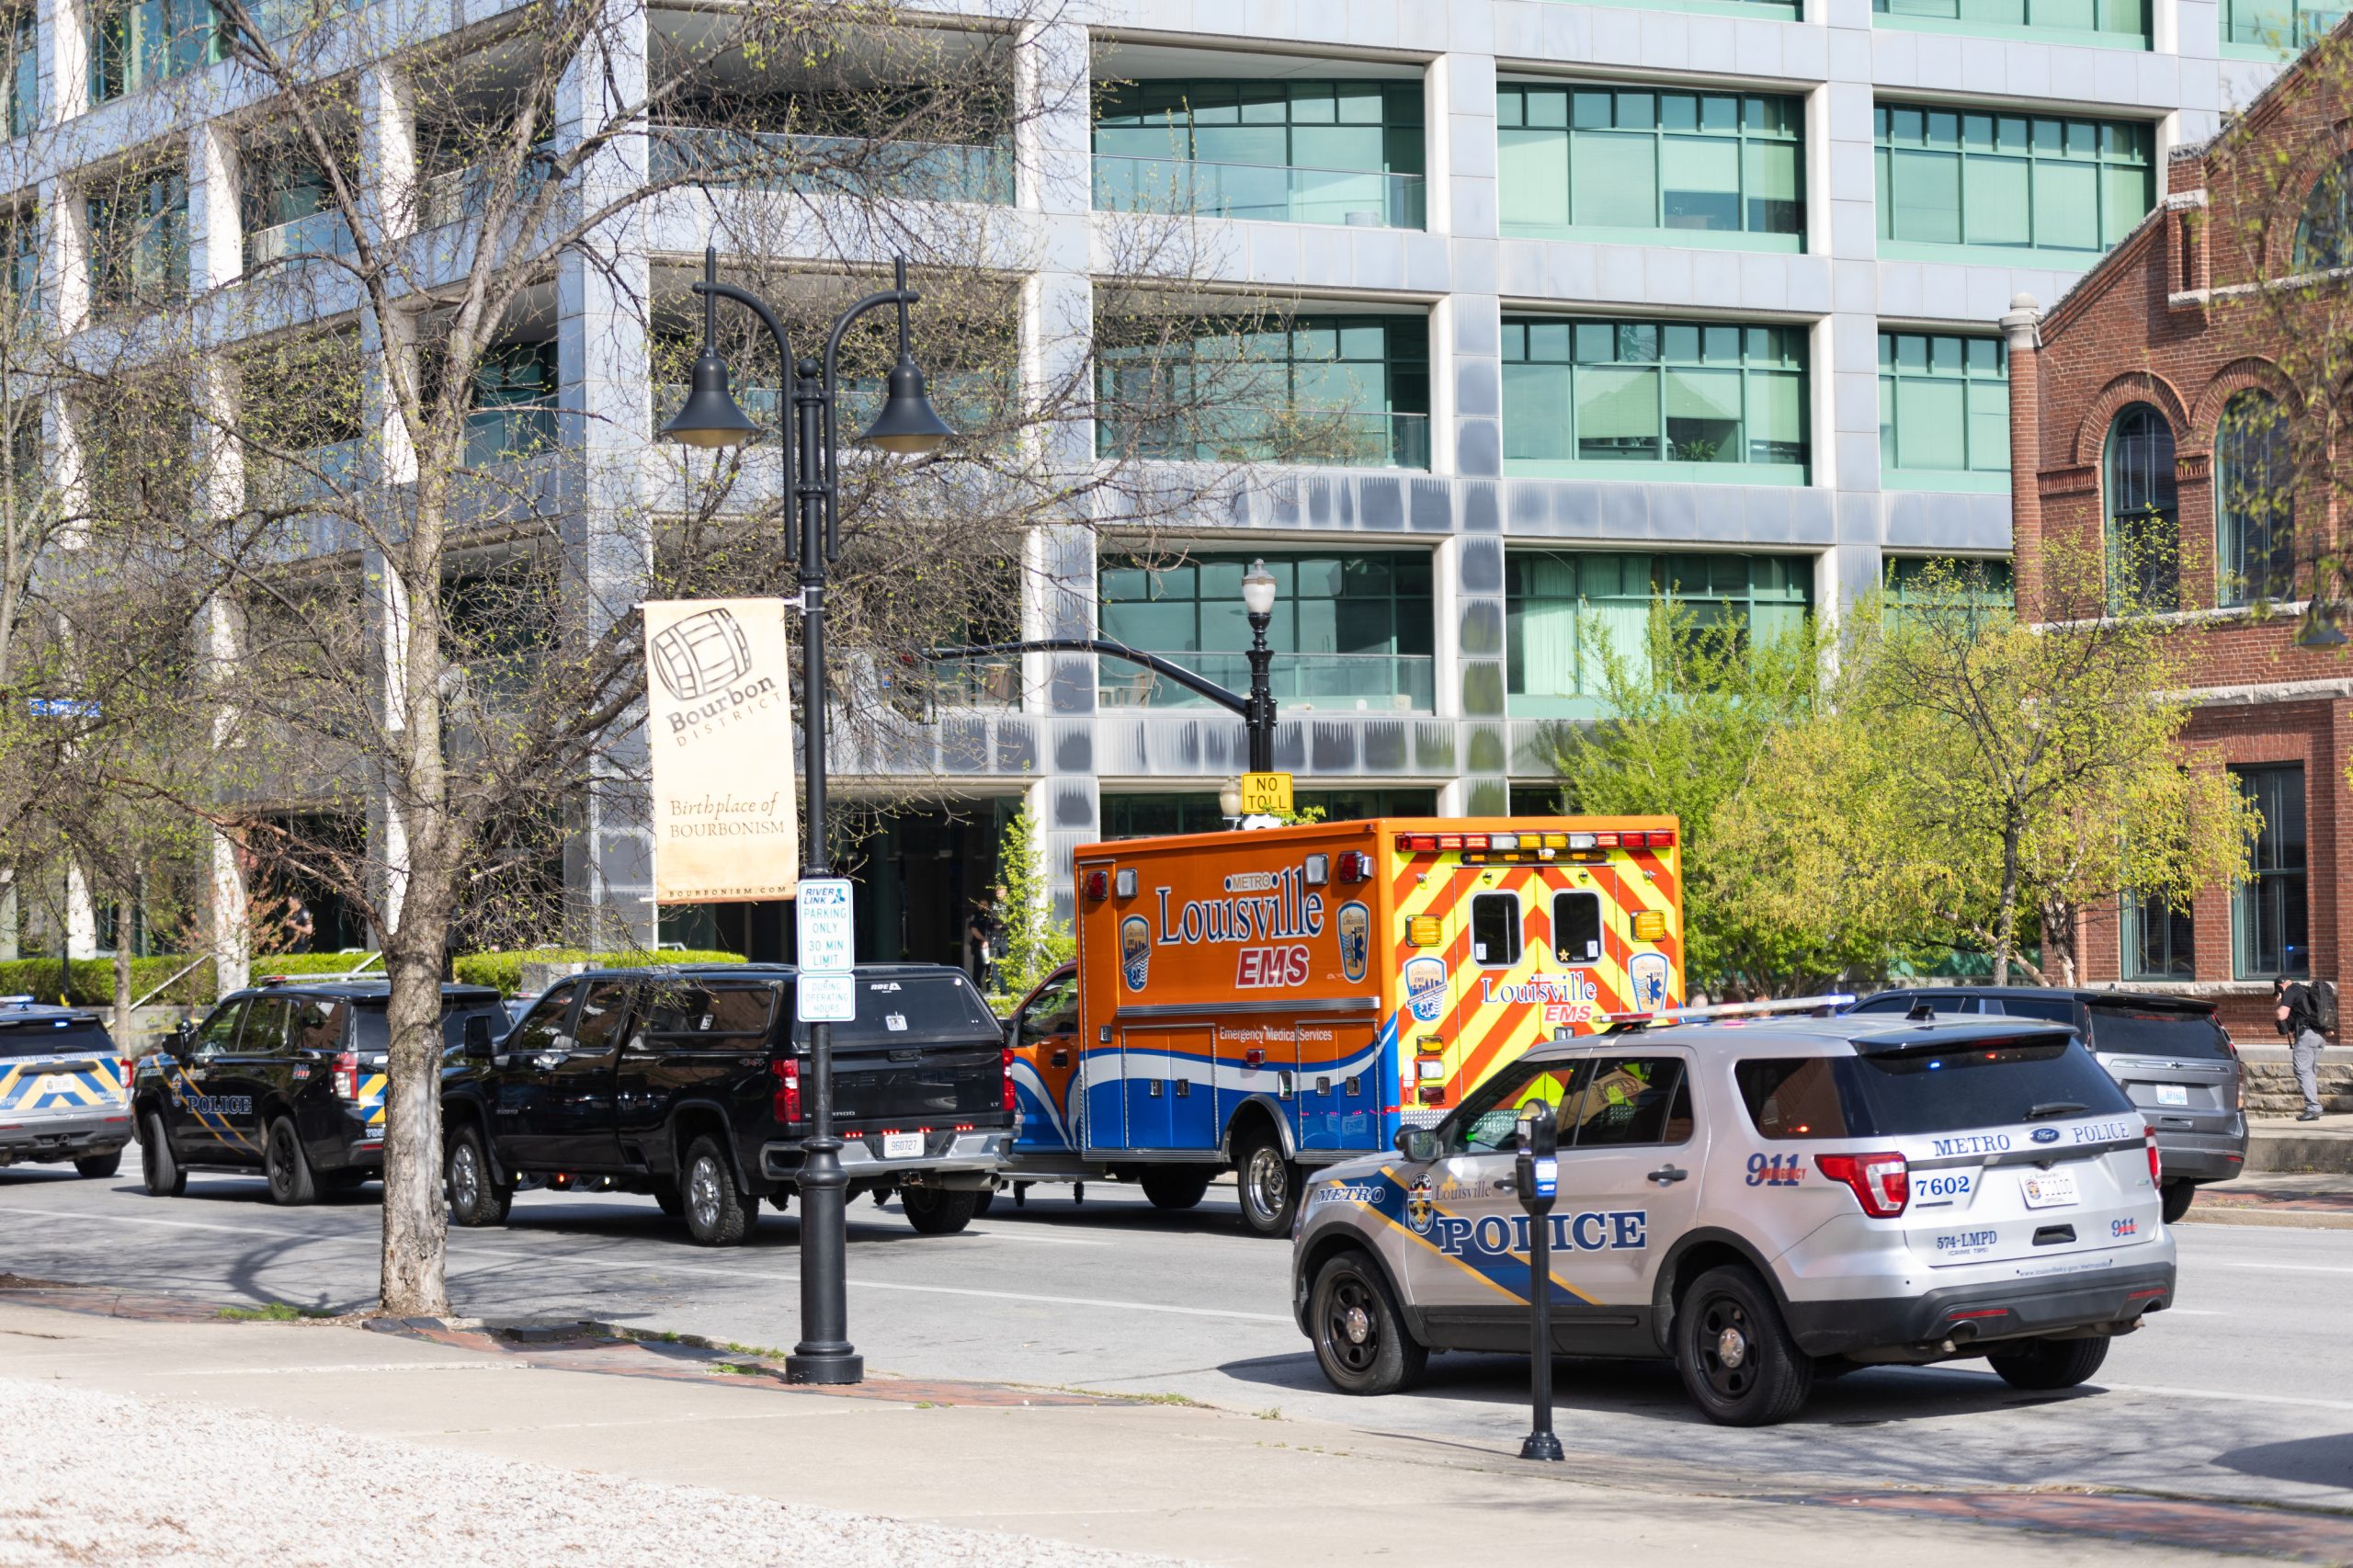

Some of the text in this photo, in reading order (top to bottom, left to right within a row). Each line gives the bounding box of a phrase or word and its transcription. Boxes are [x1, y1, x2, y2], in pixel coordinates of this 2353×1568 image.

[666, 676, 777, 733] Bourbon
[676, 692, 781, 746] DISTRICT
[1256, 778, 1278, 791] NO
[670, 791, 780, 821] Birthplace of
[1248, 795, 1287, 809] TOLL
[670, 821, 785, 838] BOURBONISM
[1233, 874, 1271, 889] METRO
[669, 887, 787, 898] BOURBONISM.COM
[804, 908, 847, 918] PARKING
[1156, 867, 1324, 946] Louisville
[813, 923, 838, 934] ONLY
[809, 940, 845, 952] 30 MIN
[813, 955, 839, 966] LIMIT
[1236, 945, 1310, 989] EMS
[812, 983, 842, 992] DURING
[1482, 971, 1597, 1004] Louisville
[805, 994, 848, 1003] OPERATING
[813, 1005, 840, 1013] HOURS
[1545, 1005, 1592, 1022] EMS
[1220, 1027, 1333, 1043] Emergency Medical Services
[187, 1095, 252, 1115] POLICE
[891, 1140, 917, 1152] 960727
[1932, 1122, 2130, 1157] METRO Ford POLICE
[1745, 1153, 1799, 1187] 911
[1436, 1181, 1491, 1200] Louisville
[1915, 1176, 1971, 1197] 7602
[1316, 1187, 1385, 1204] METRO
[1437, 1210, 1648, 1256] POLICE
[2111, 1217, 2136, 1237] 911
[1937, 1230, 1997, 1250] 574-LMPD
